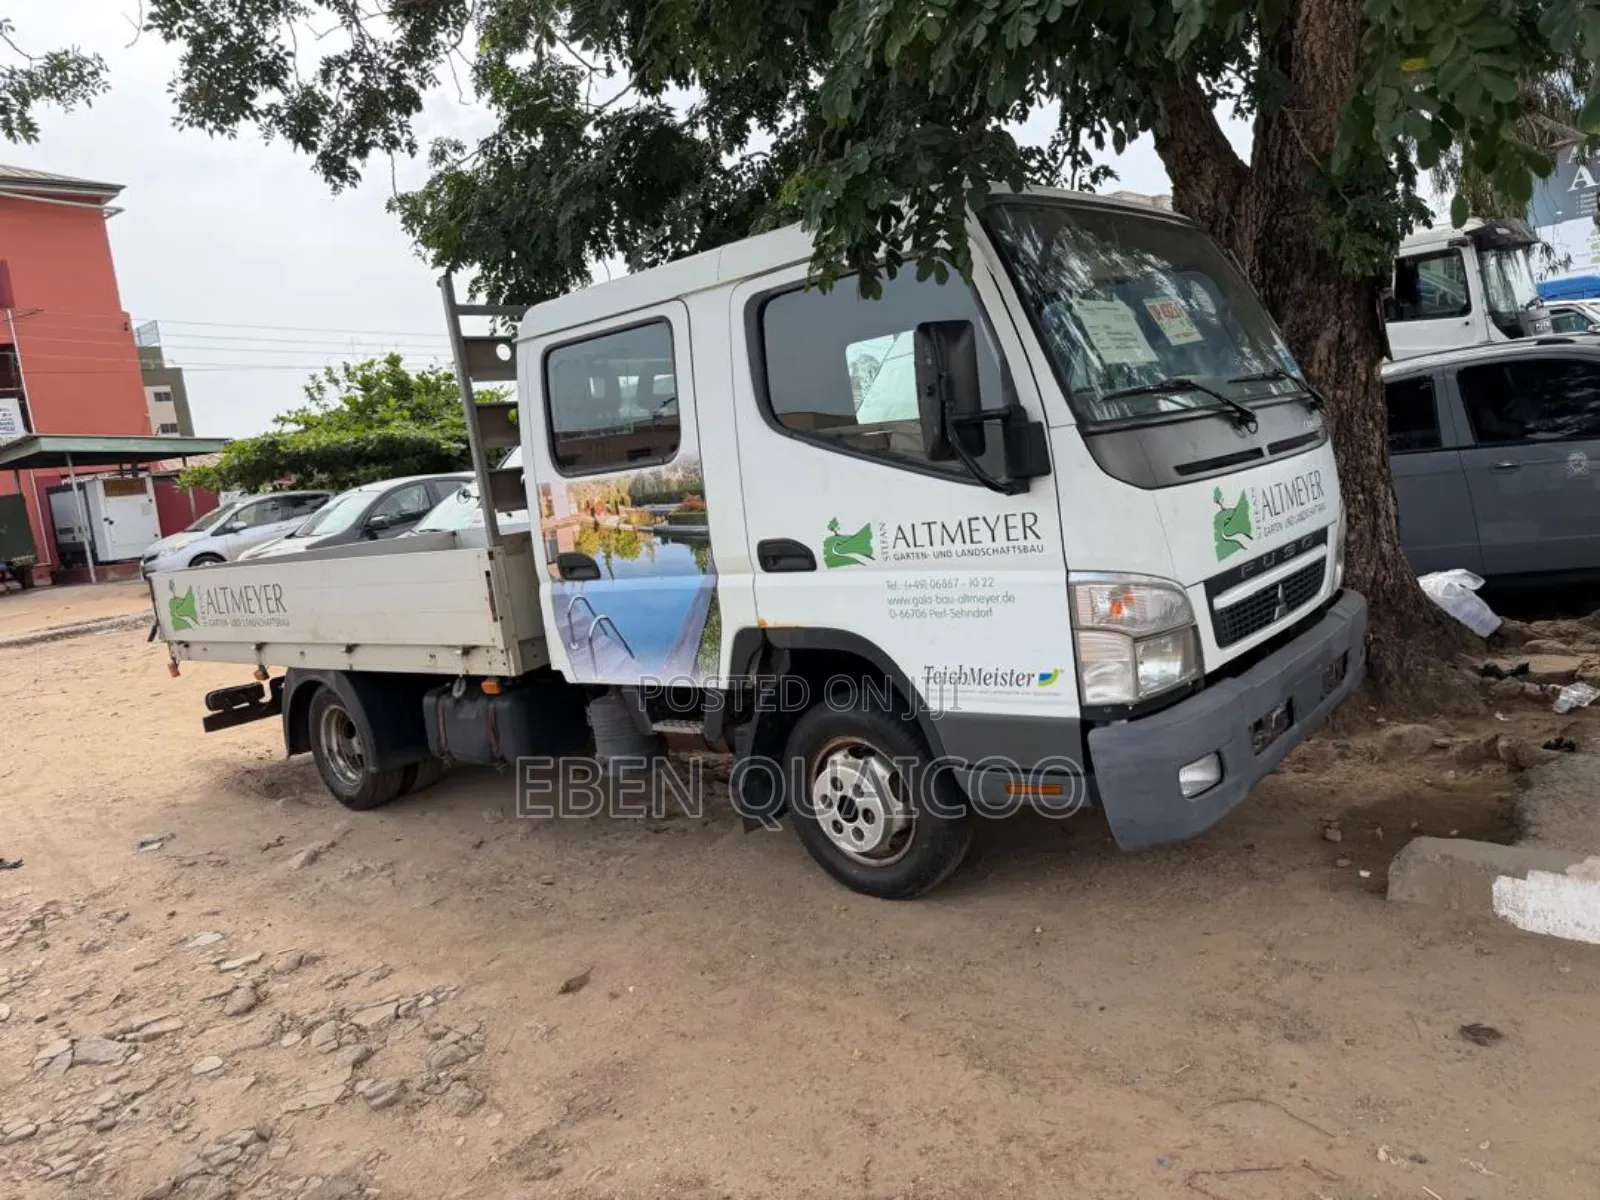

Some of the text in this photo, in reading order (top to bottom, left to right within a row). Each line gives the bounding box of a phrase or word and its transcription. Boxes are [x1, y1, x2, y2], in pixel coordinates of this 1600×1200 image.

[1261, 470, 1325, 521] ALTMEYER
[892, 511, 1042, 550] ALTMEYER
[893, 544, 1044, 561] GARTEN- UND LANDSCHAFTSBAU
[206, 583, 287, 615] ALTMEYER
[924, 665, 1035, 687] TeichMeister
